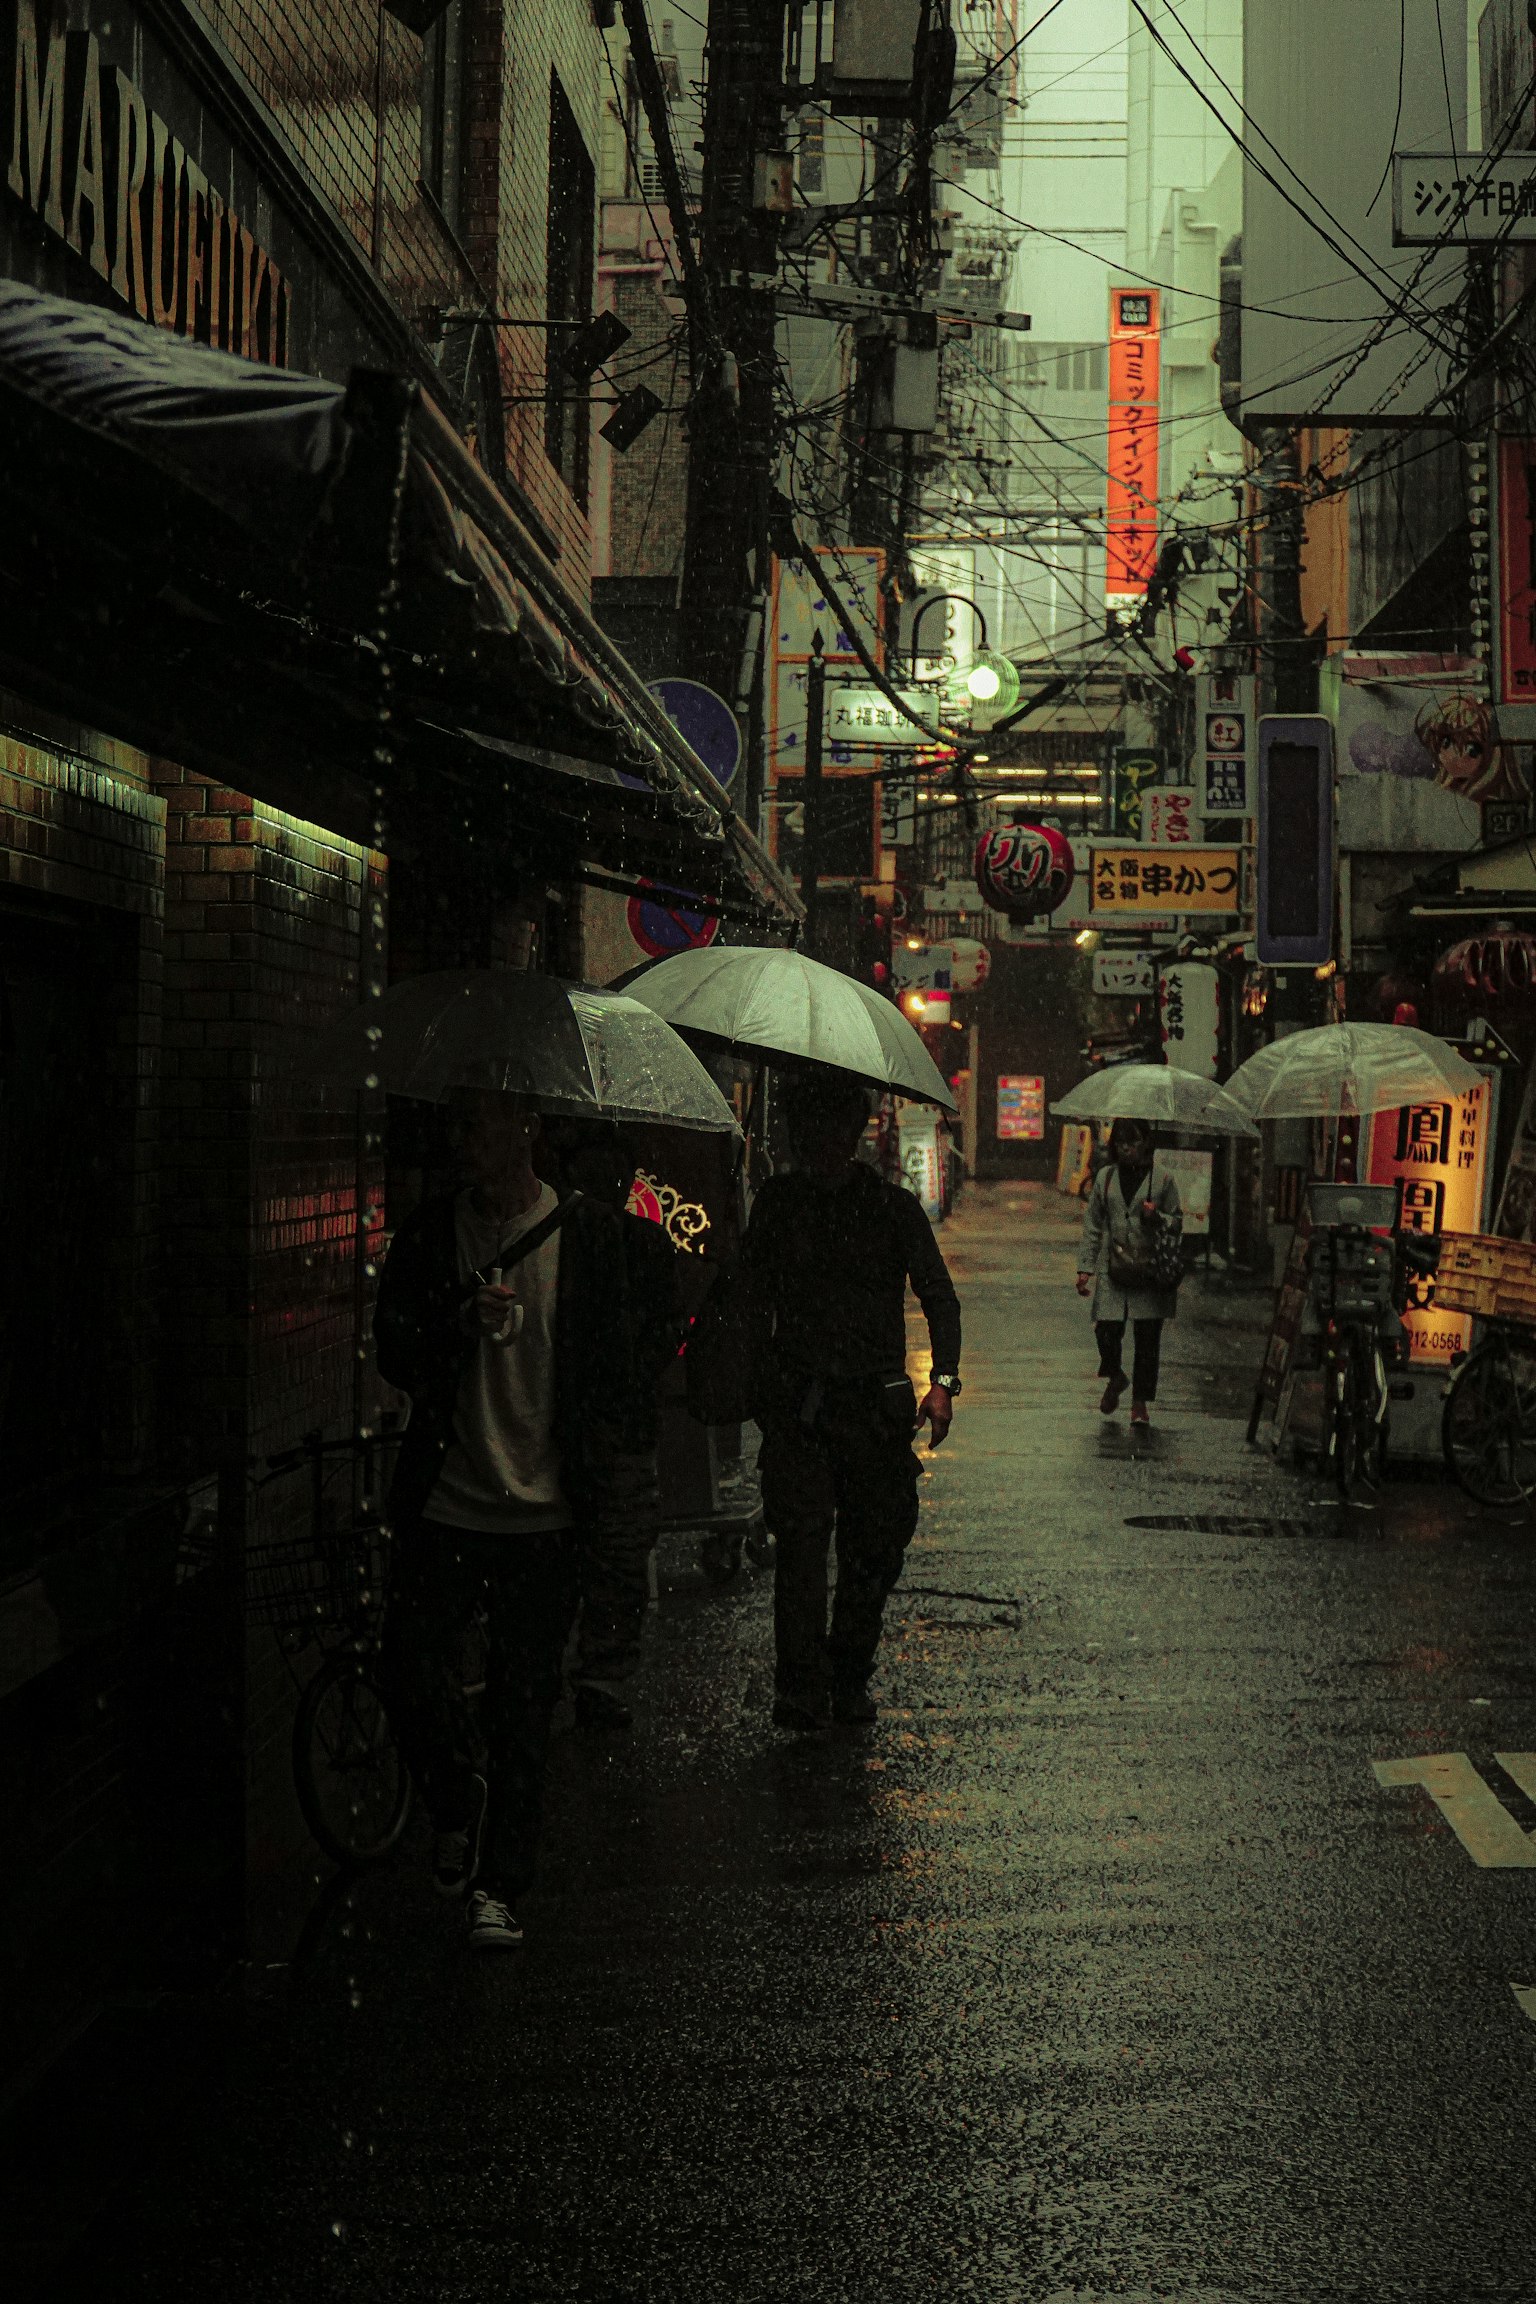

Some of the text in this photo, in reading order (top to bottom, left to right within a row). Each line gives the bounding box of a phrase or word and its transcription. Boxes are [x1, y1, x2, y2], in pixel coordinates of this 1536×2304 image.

[1491, 815, 1518, 833] 2F
[1097, 858, 1139, 878] 大阪
[1142, 863, 1237, 898] 串かつ
[1458, 1089, 1481, 1168] 中華料理
